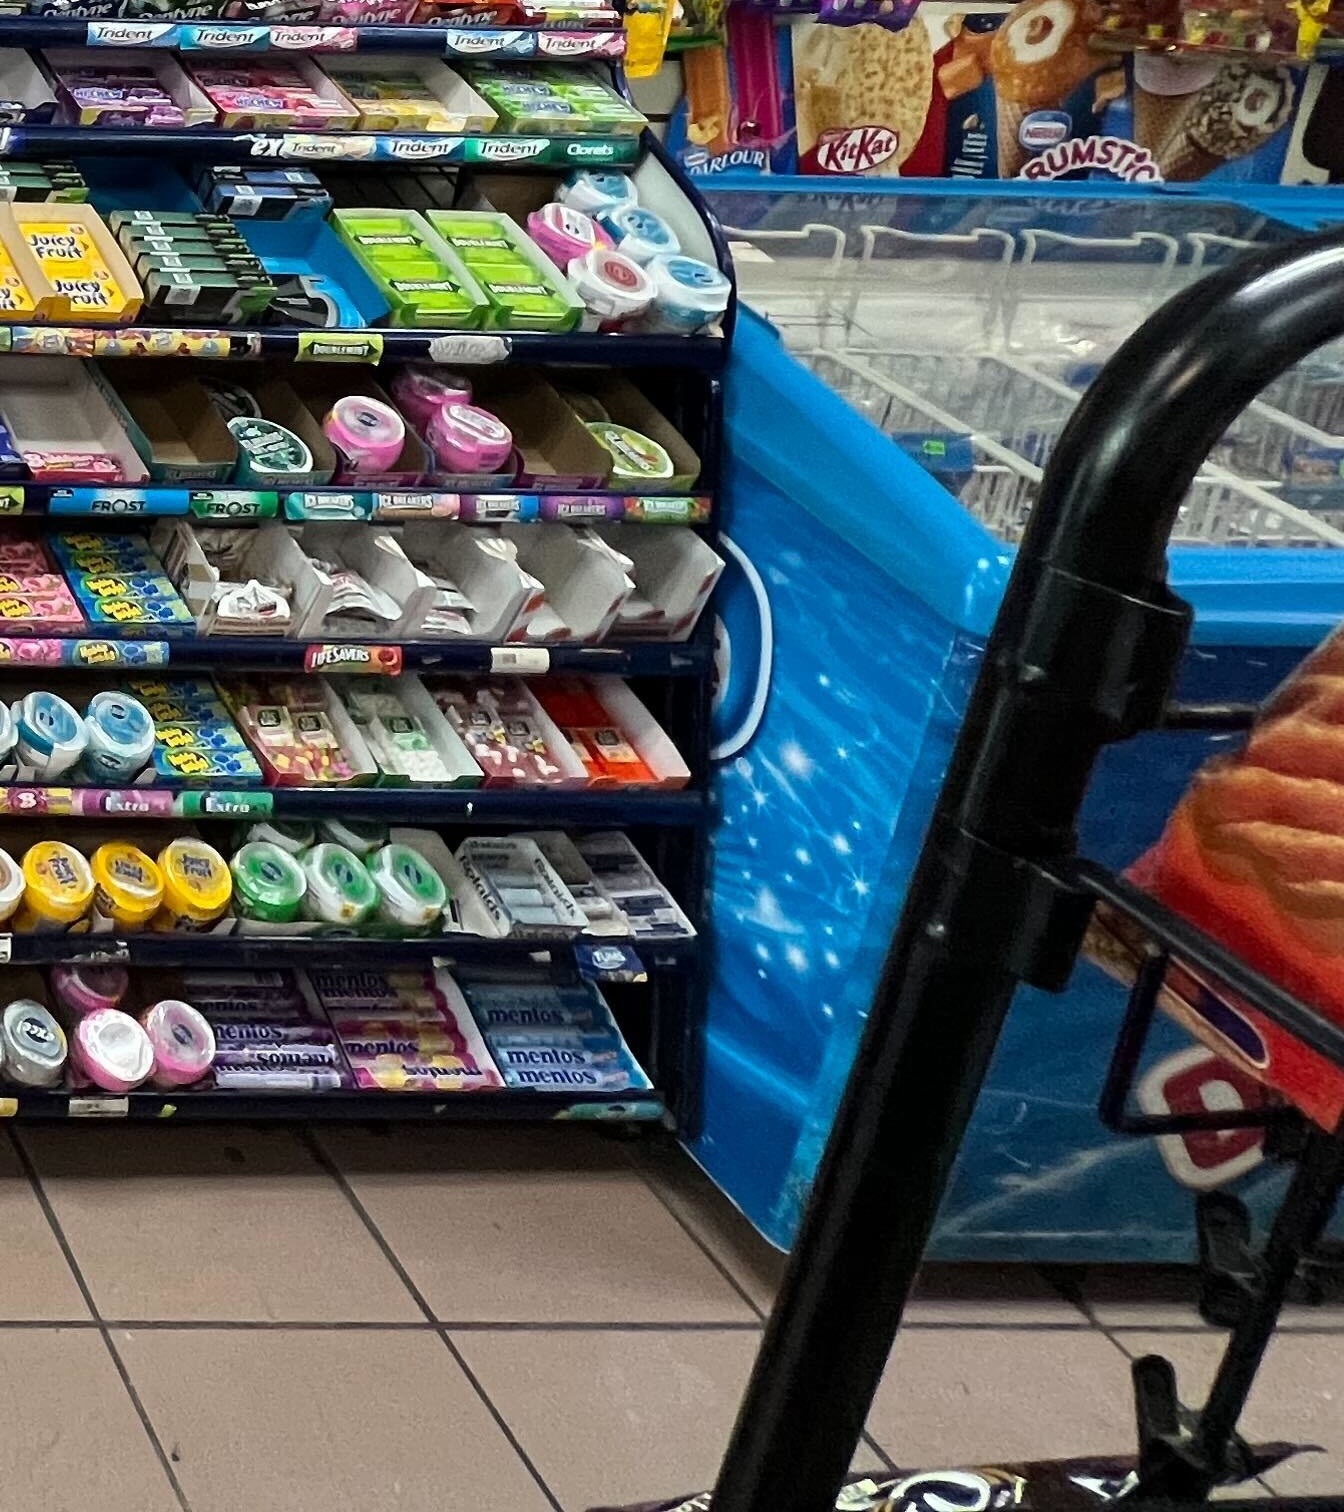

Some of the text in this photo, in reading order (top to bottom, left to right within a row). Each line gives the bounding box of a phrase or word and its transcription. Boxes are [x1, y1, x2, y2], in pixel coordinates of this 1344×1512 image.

[390, 141, 449, 155] Trident
[480, 141, 539, 156] Trident
[567, 143, 614, 157] Clorets
[819, 131, 897, 171] KitKat
[313, 344, 369, 356] DOUBLEMINT
[91, 499, 147, 513] FROST
[311, 647, 369, 666] LIFESAVERS
[460, 856, 502, 923] Rolaids
[506, 1048, 586, 1065] mentos
[518, 1068, 597, 1085] mentos
